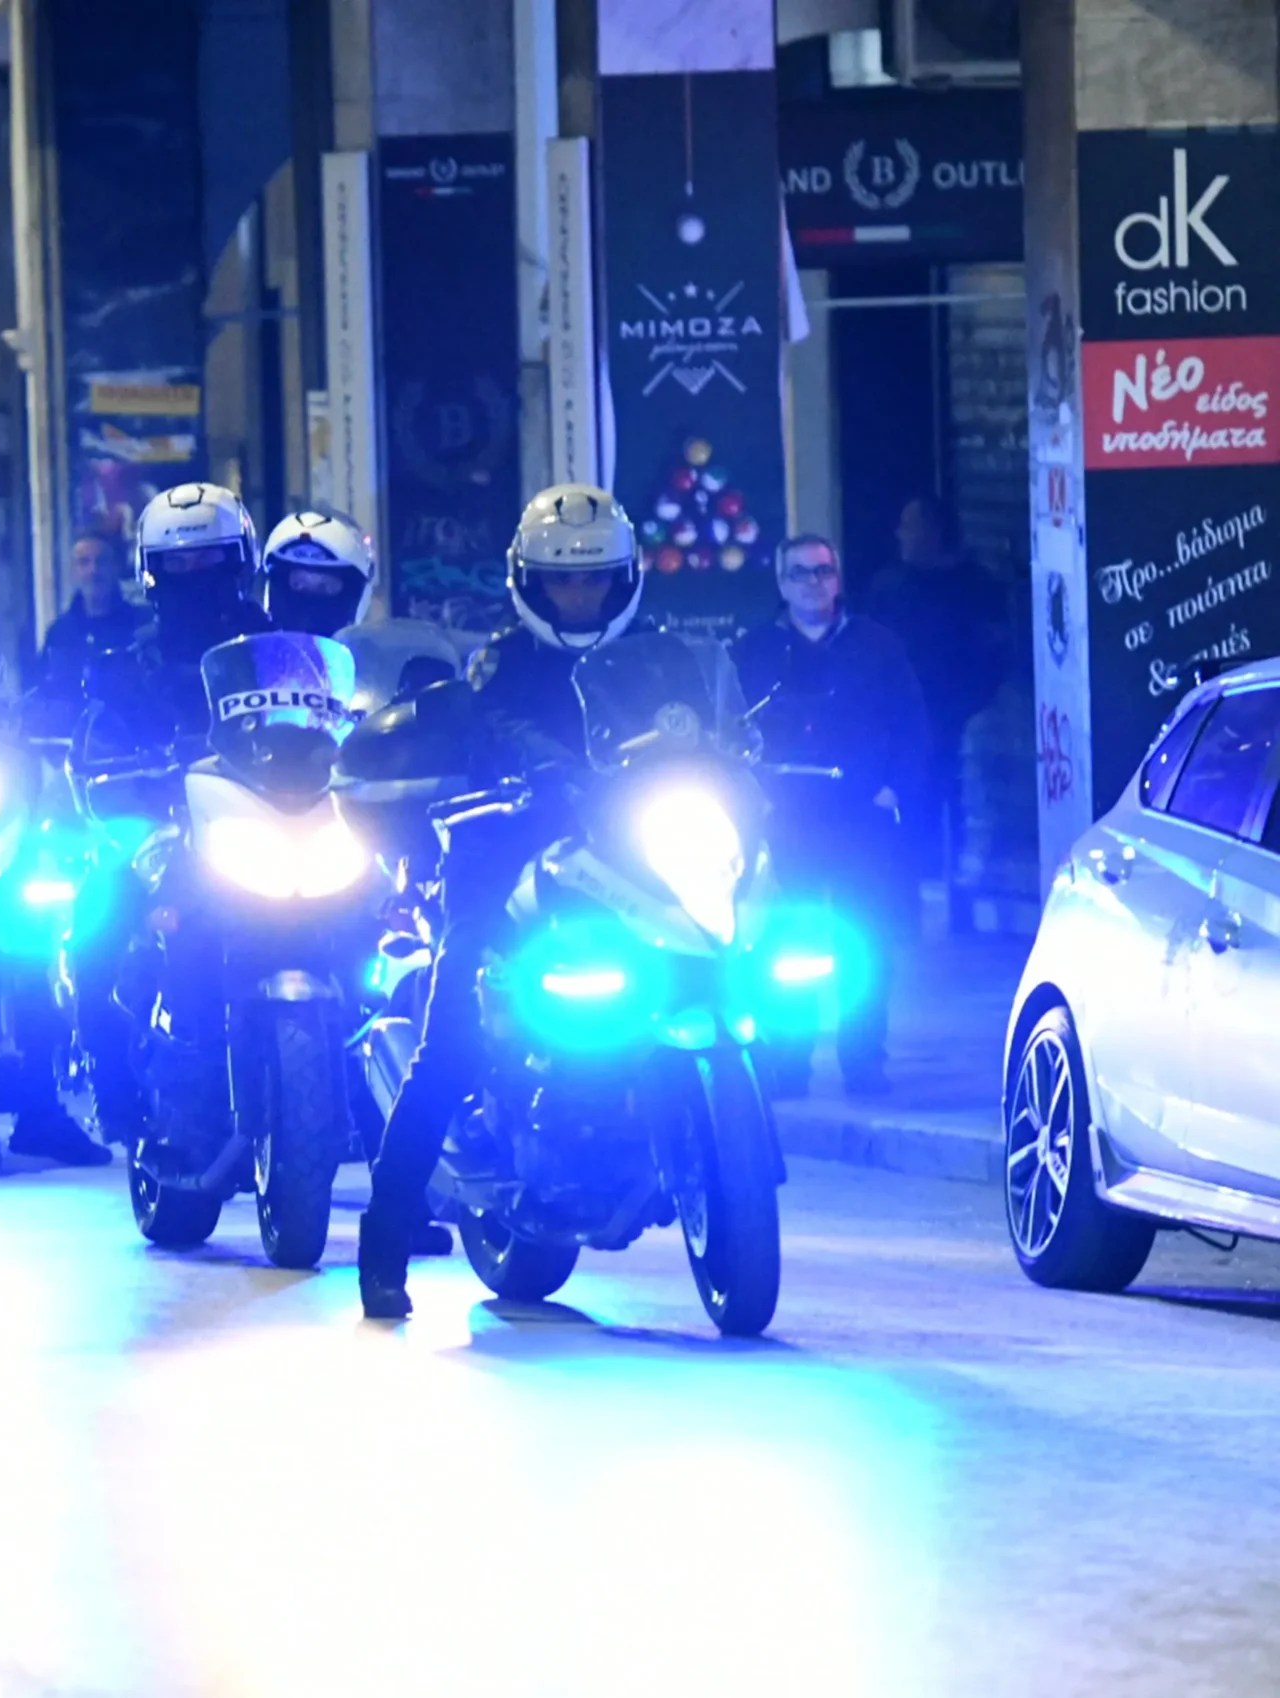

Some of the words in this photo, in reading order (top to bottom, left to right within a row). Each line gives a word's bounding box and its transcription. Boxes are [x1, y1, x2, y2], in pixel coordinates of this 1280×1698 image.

[780, 166, 832, 194] ND
[932, 159, 1025, 190] OUTL
[1115, 279, 1247, 315] fashion
[619, 315, 763, 340] MIMOZA
[1112, 348, 1204, 424] Νέο
[1195, 381, 1269, 419] είδος
[1102, 419, 1267, 462] υποδήματα
[1124, 620, 1154, 651] σε
[1166, 559, 1272, 629] ποιότητα
[1148, 658, 1180, 698] &
